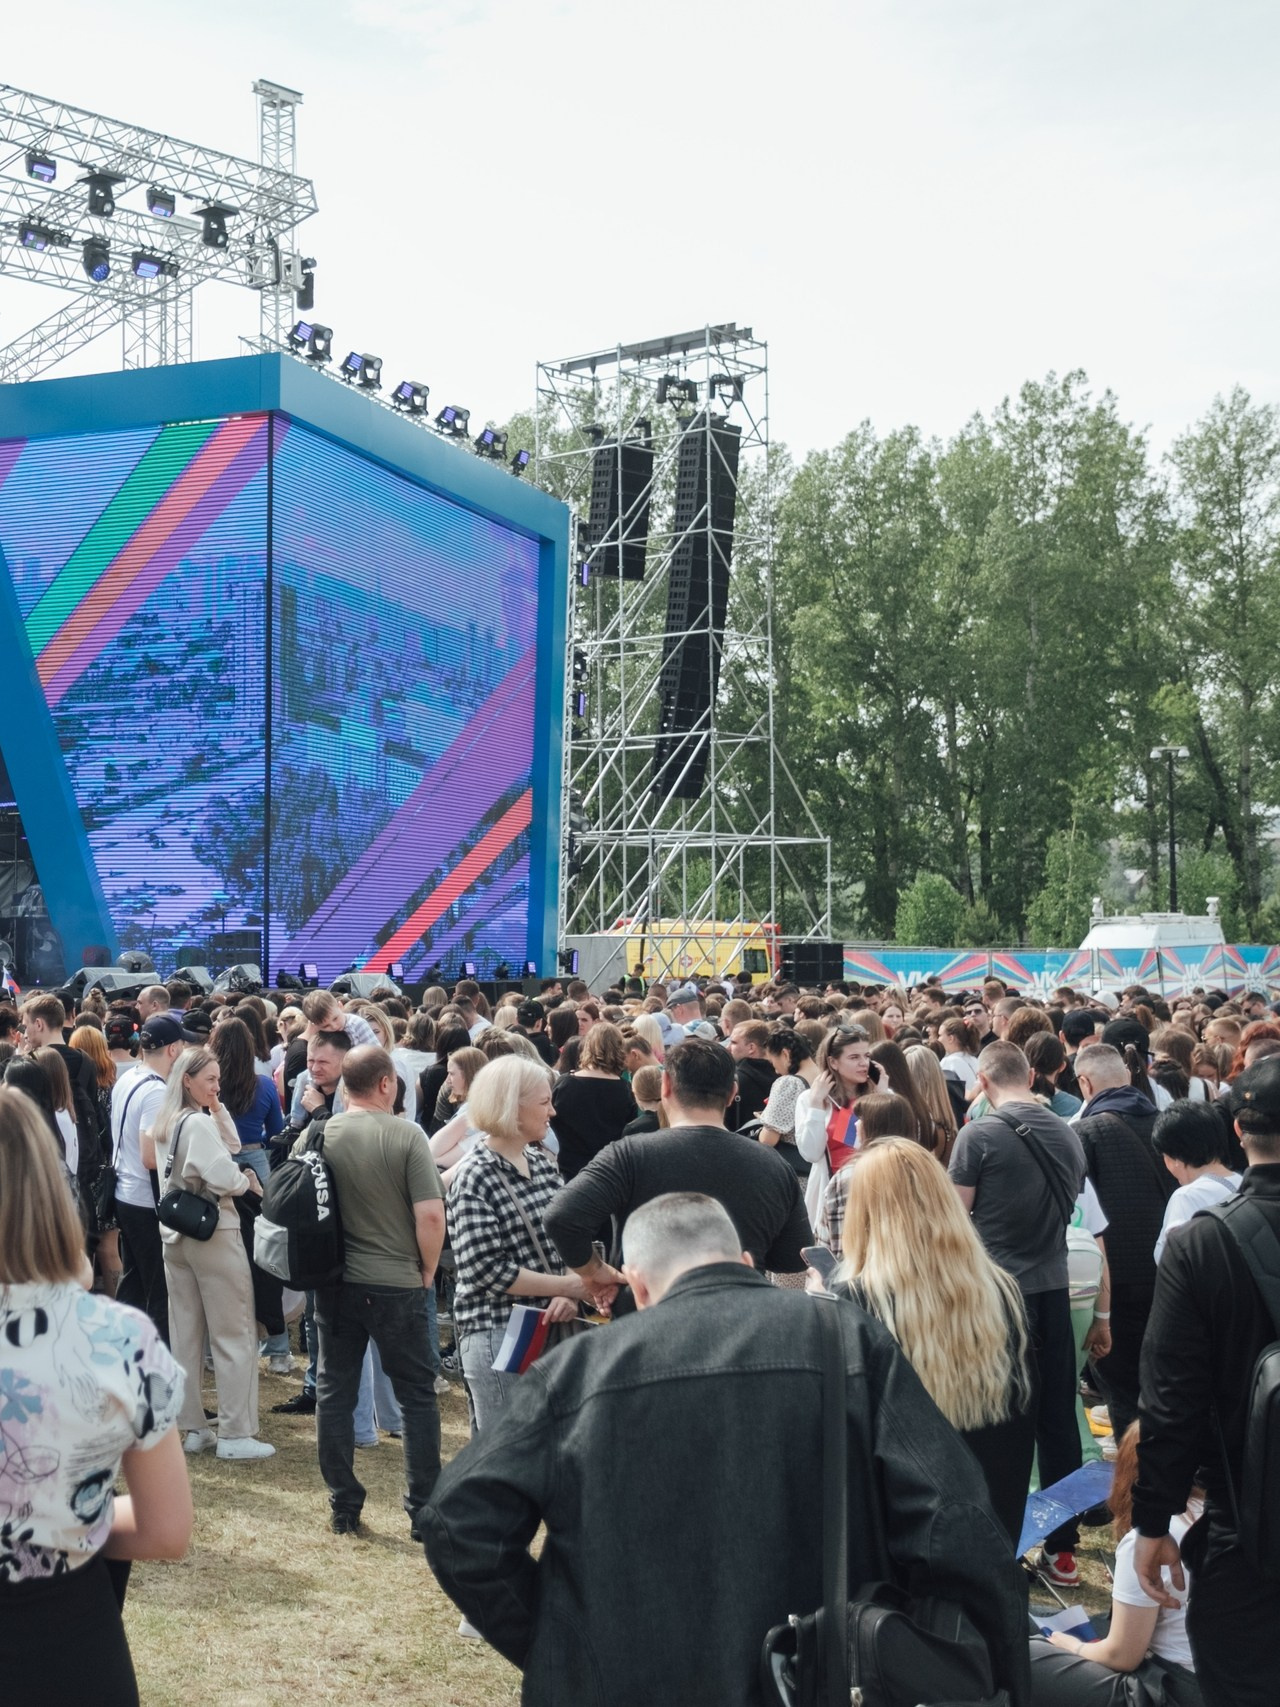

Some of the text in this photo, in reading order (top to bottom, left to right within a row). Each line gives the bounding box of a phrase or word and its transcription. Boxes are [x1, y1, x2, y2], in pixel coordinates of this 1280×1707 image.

[897, 971, 934, 988] VK
[1032, 971, 1058, 988] VK
[1185, 963, 1201, 979] VK
